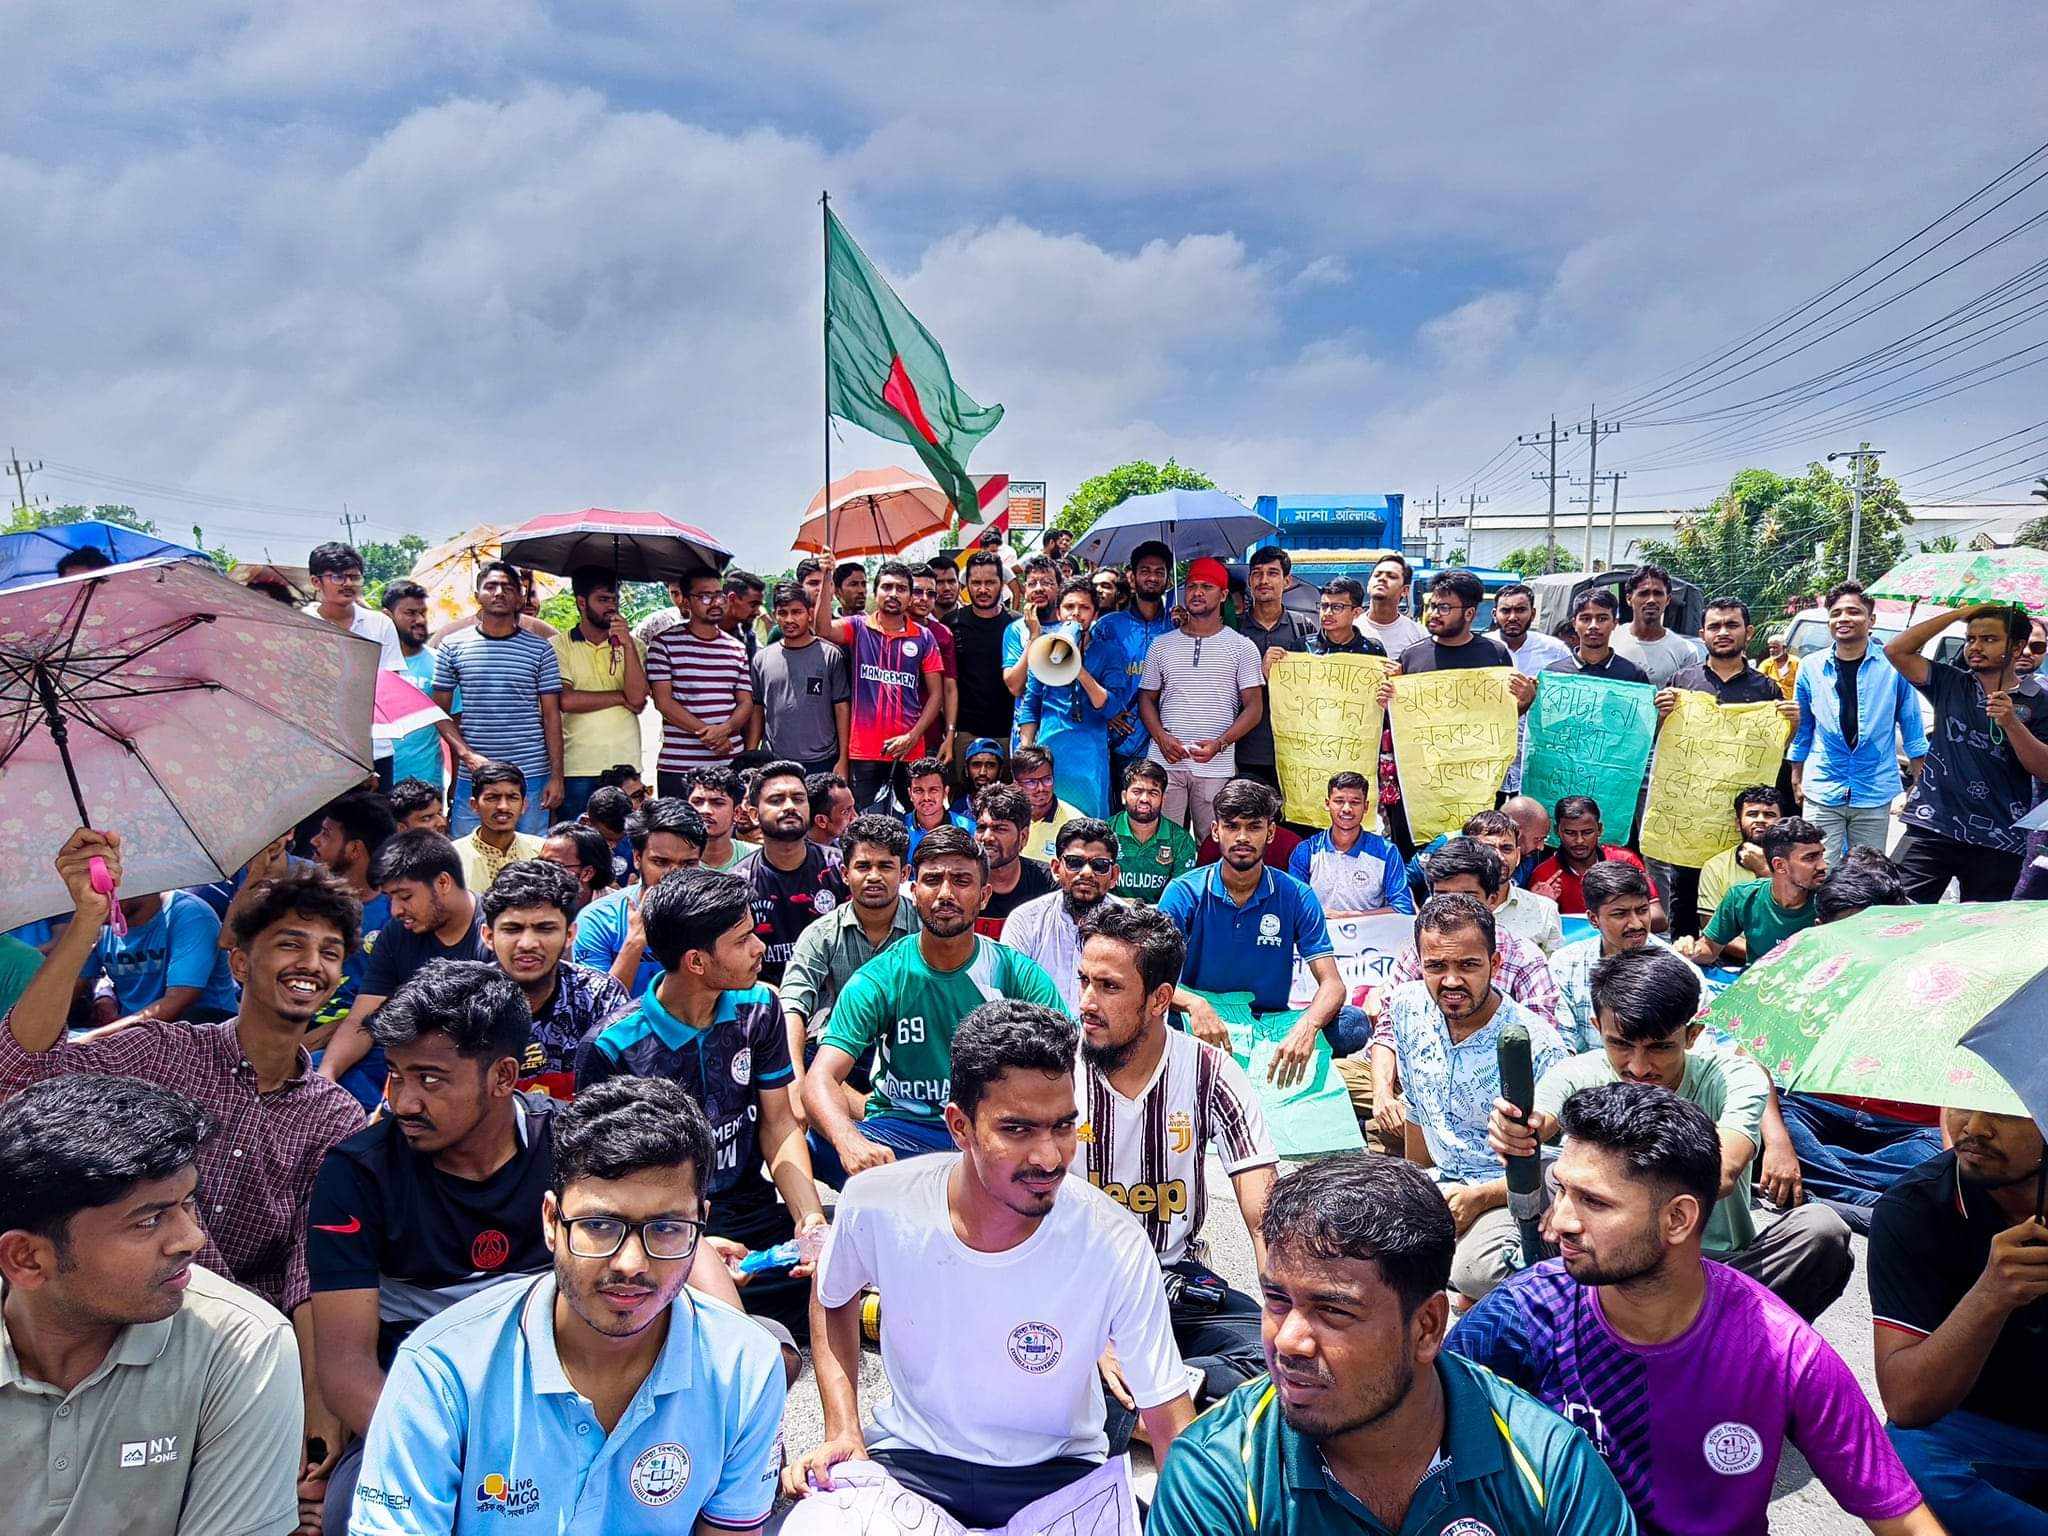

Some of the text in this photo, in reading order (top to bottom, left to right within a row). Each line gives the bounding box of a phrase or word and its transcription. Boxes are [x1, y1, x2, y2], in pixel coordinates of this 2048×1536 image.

[1295, 510, 1329, 521] মাশা
[1610, 691, 1639, 729] না
[898, 1017, 925, 1044] 69
[1088, 1171, 1187, 1223] eep
[151, 1436, 177, 1454] NY
[508, 1478, 533, 1492] Live
[506, 1488, 539, 1507] MCQ
